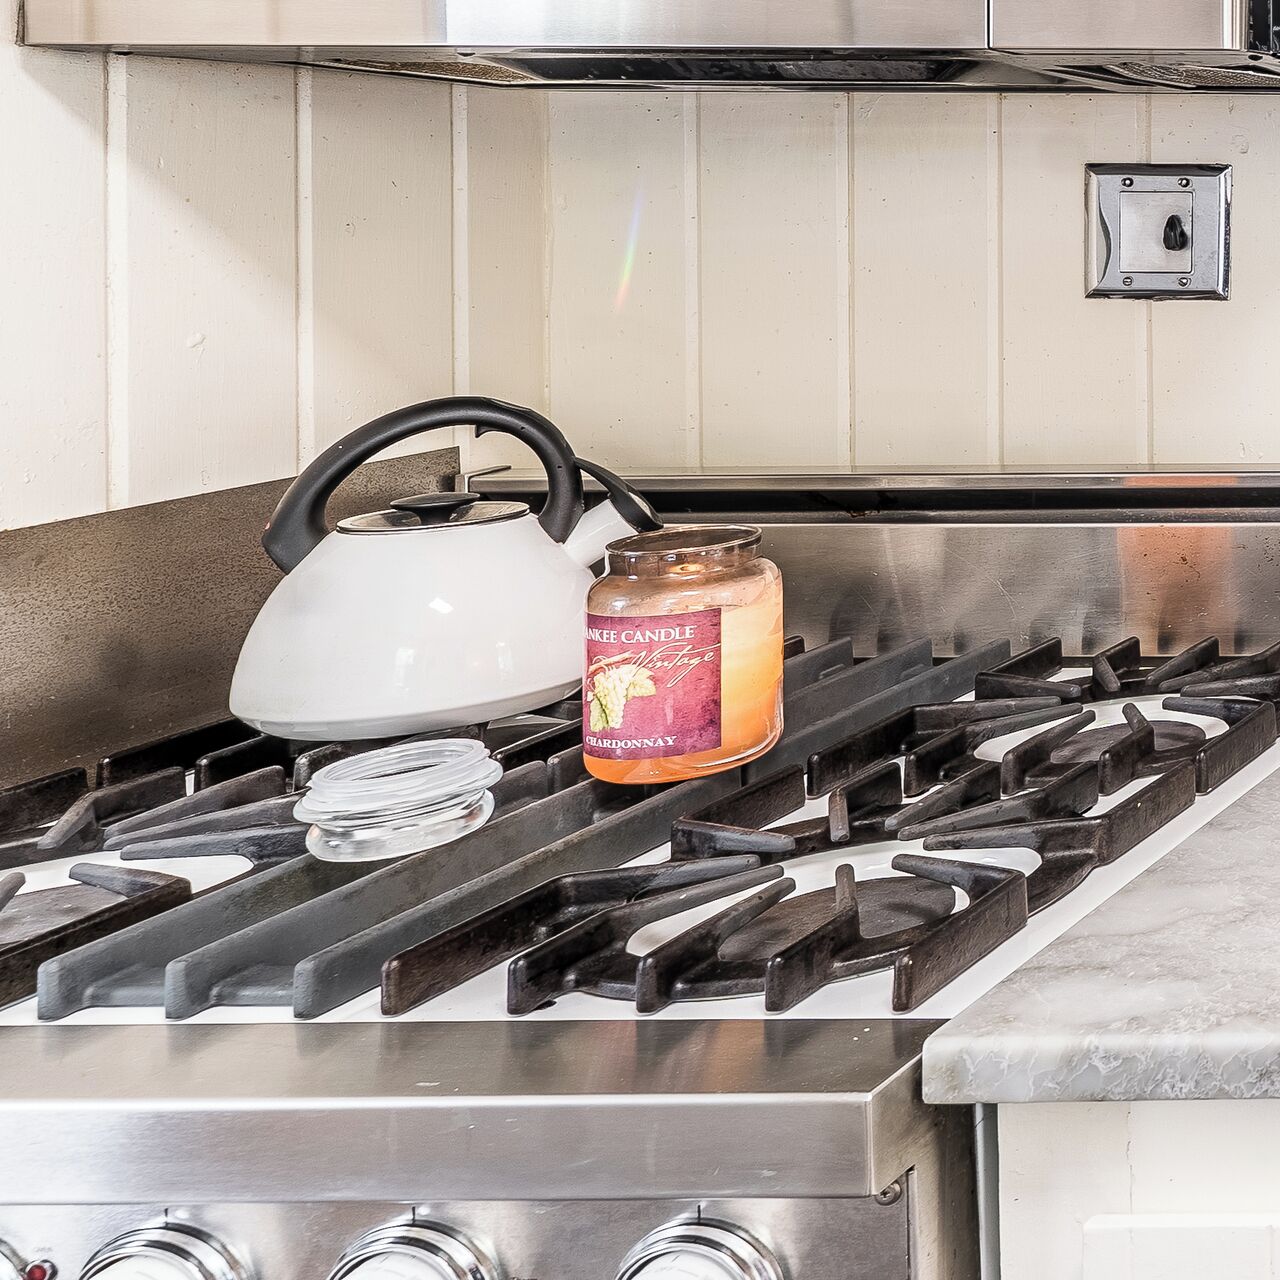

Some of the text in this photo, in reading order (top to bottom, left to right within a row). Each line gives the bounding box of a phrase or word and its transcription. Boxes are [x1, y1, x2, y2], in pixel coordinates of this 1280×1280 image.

[585, 625, 695, 644] ANKEE CANDLE
[631, 642, 721, 688] Vintage
[586, 735, 677, 749] CHARDONNAY
